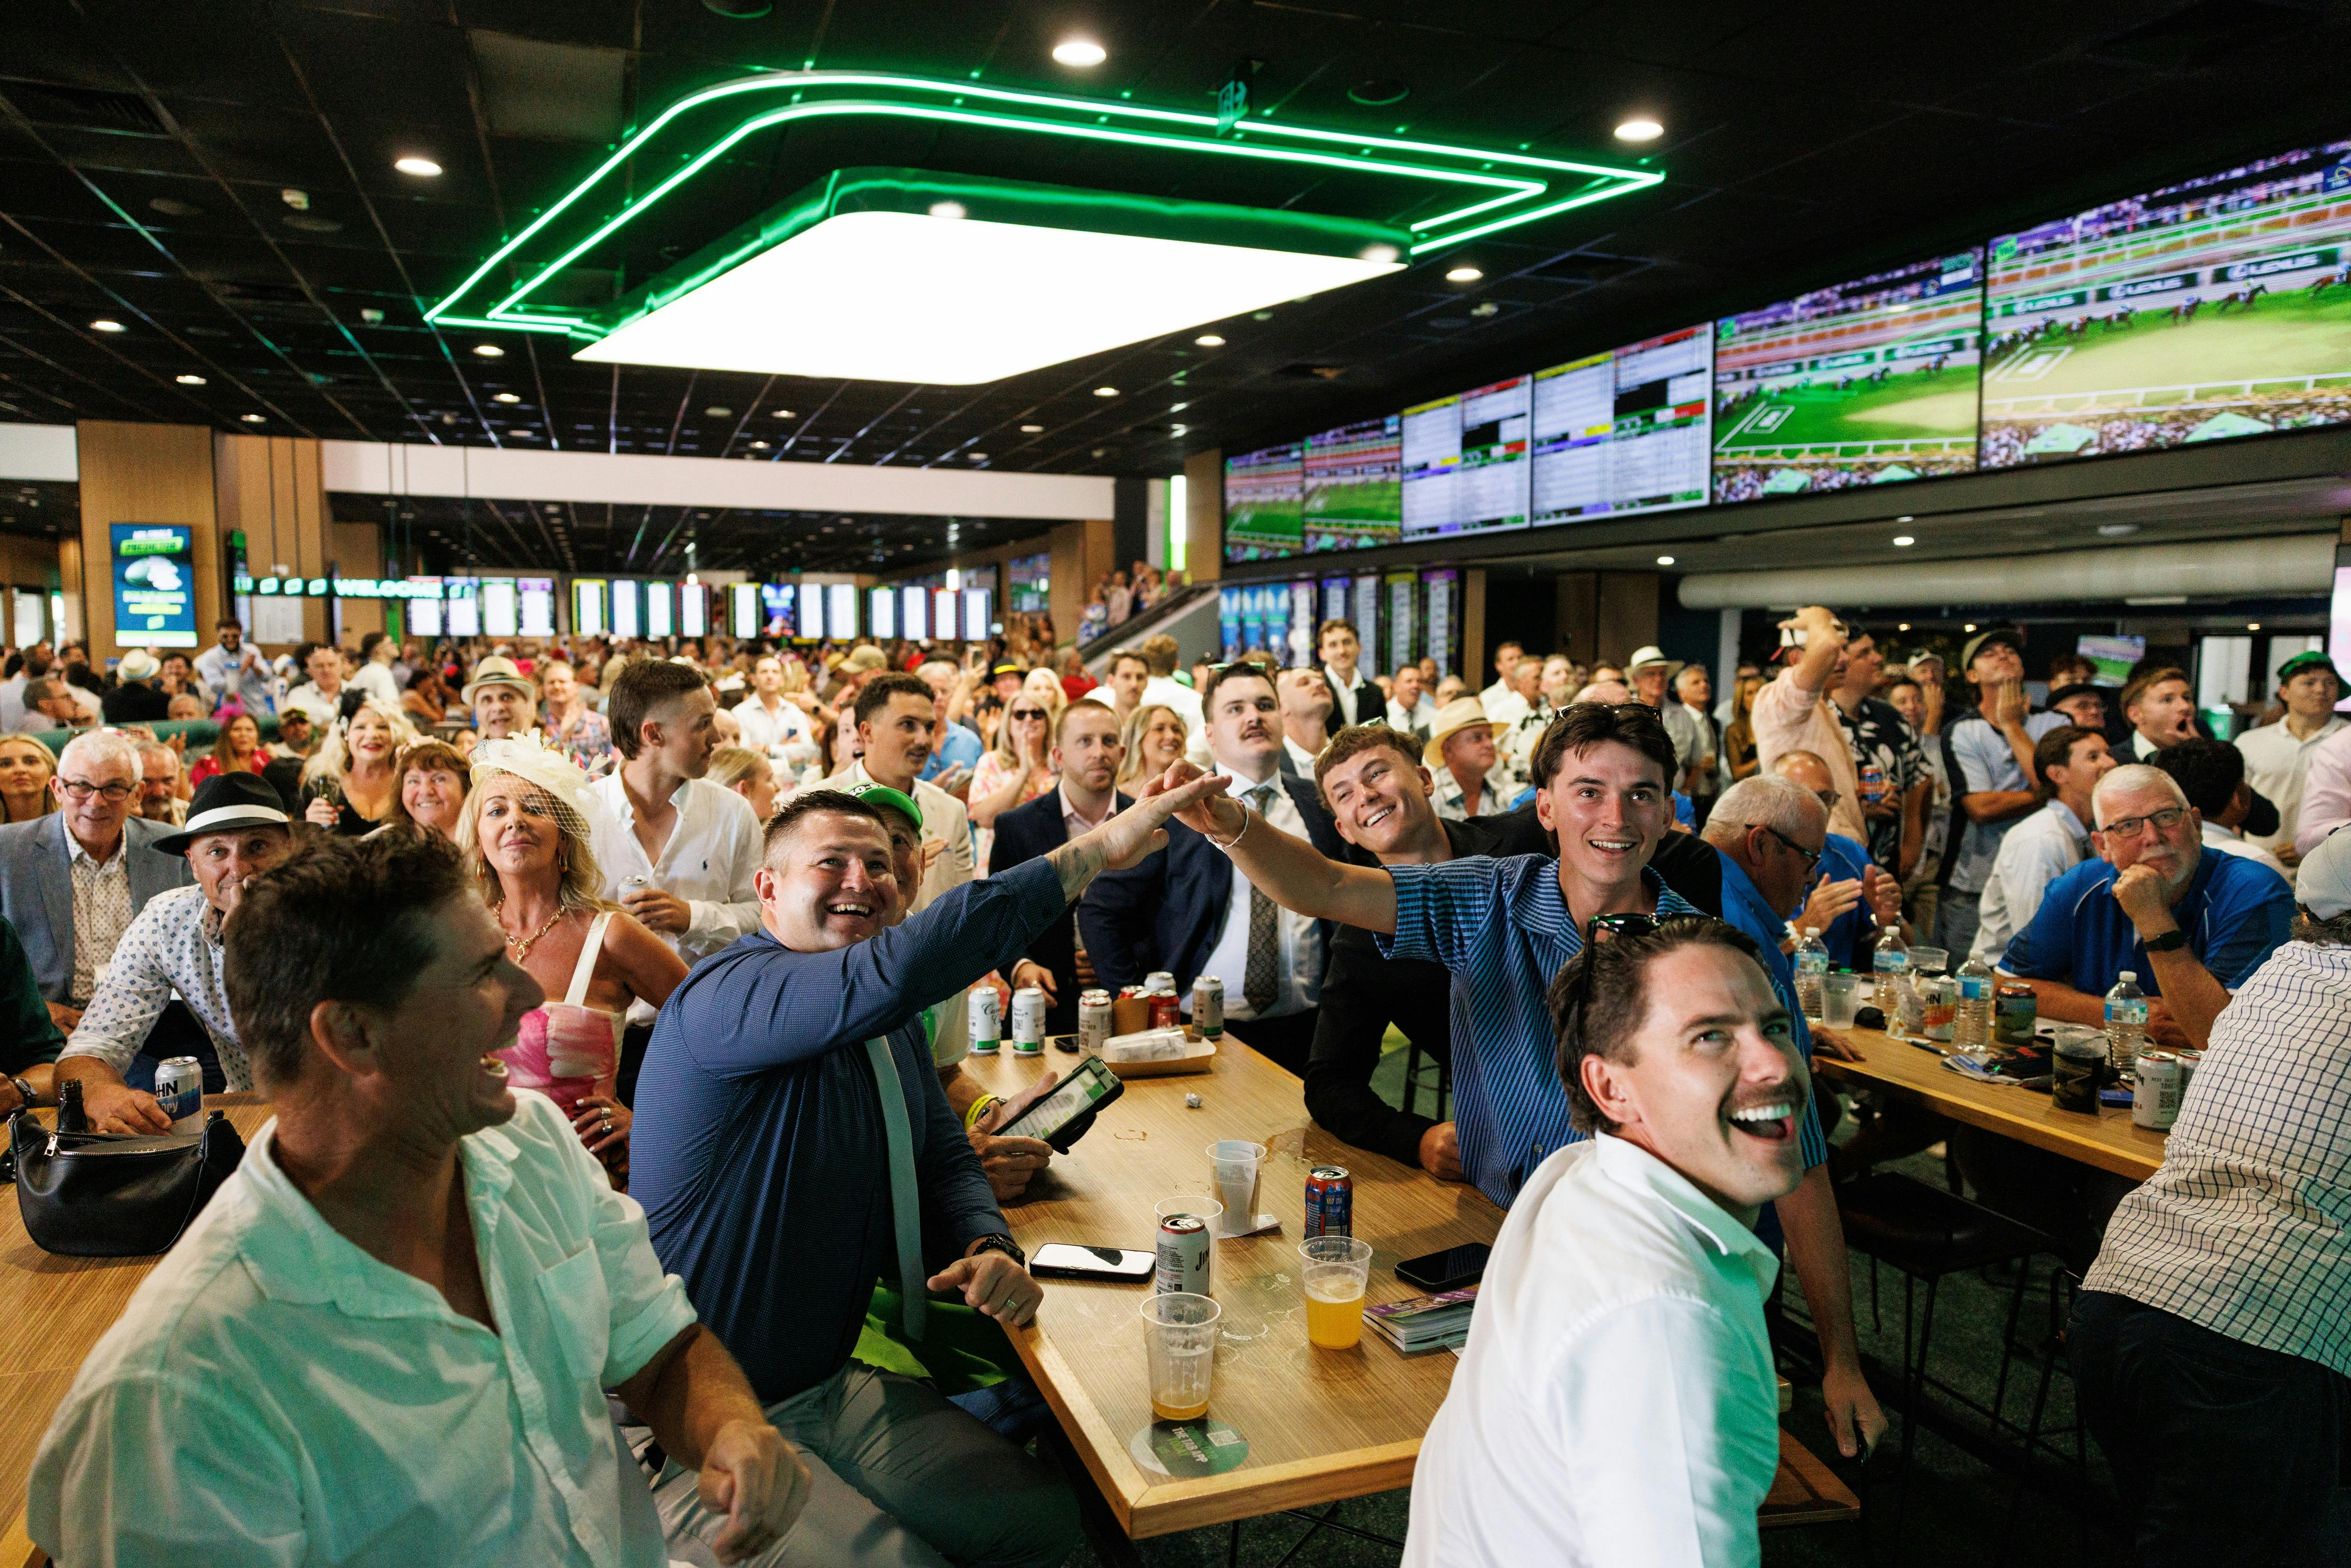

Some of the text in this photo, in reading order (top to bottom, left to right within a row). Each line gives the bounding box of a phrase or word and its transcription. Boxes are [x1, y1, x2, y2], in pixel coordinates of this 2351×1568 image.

[333, 579, 444, 599] WELCOME
[156, 1080, 178, 1098] HN
[1172, 1426, 1209, 1463] THE TAB APP
